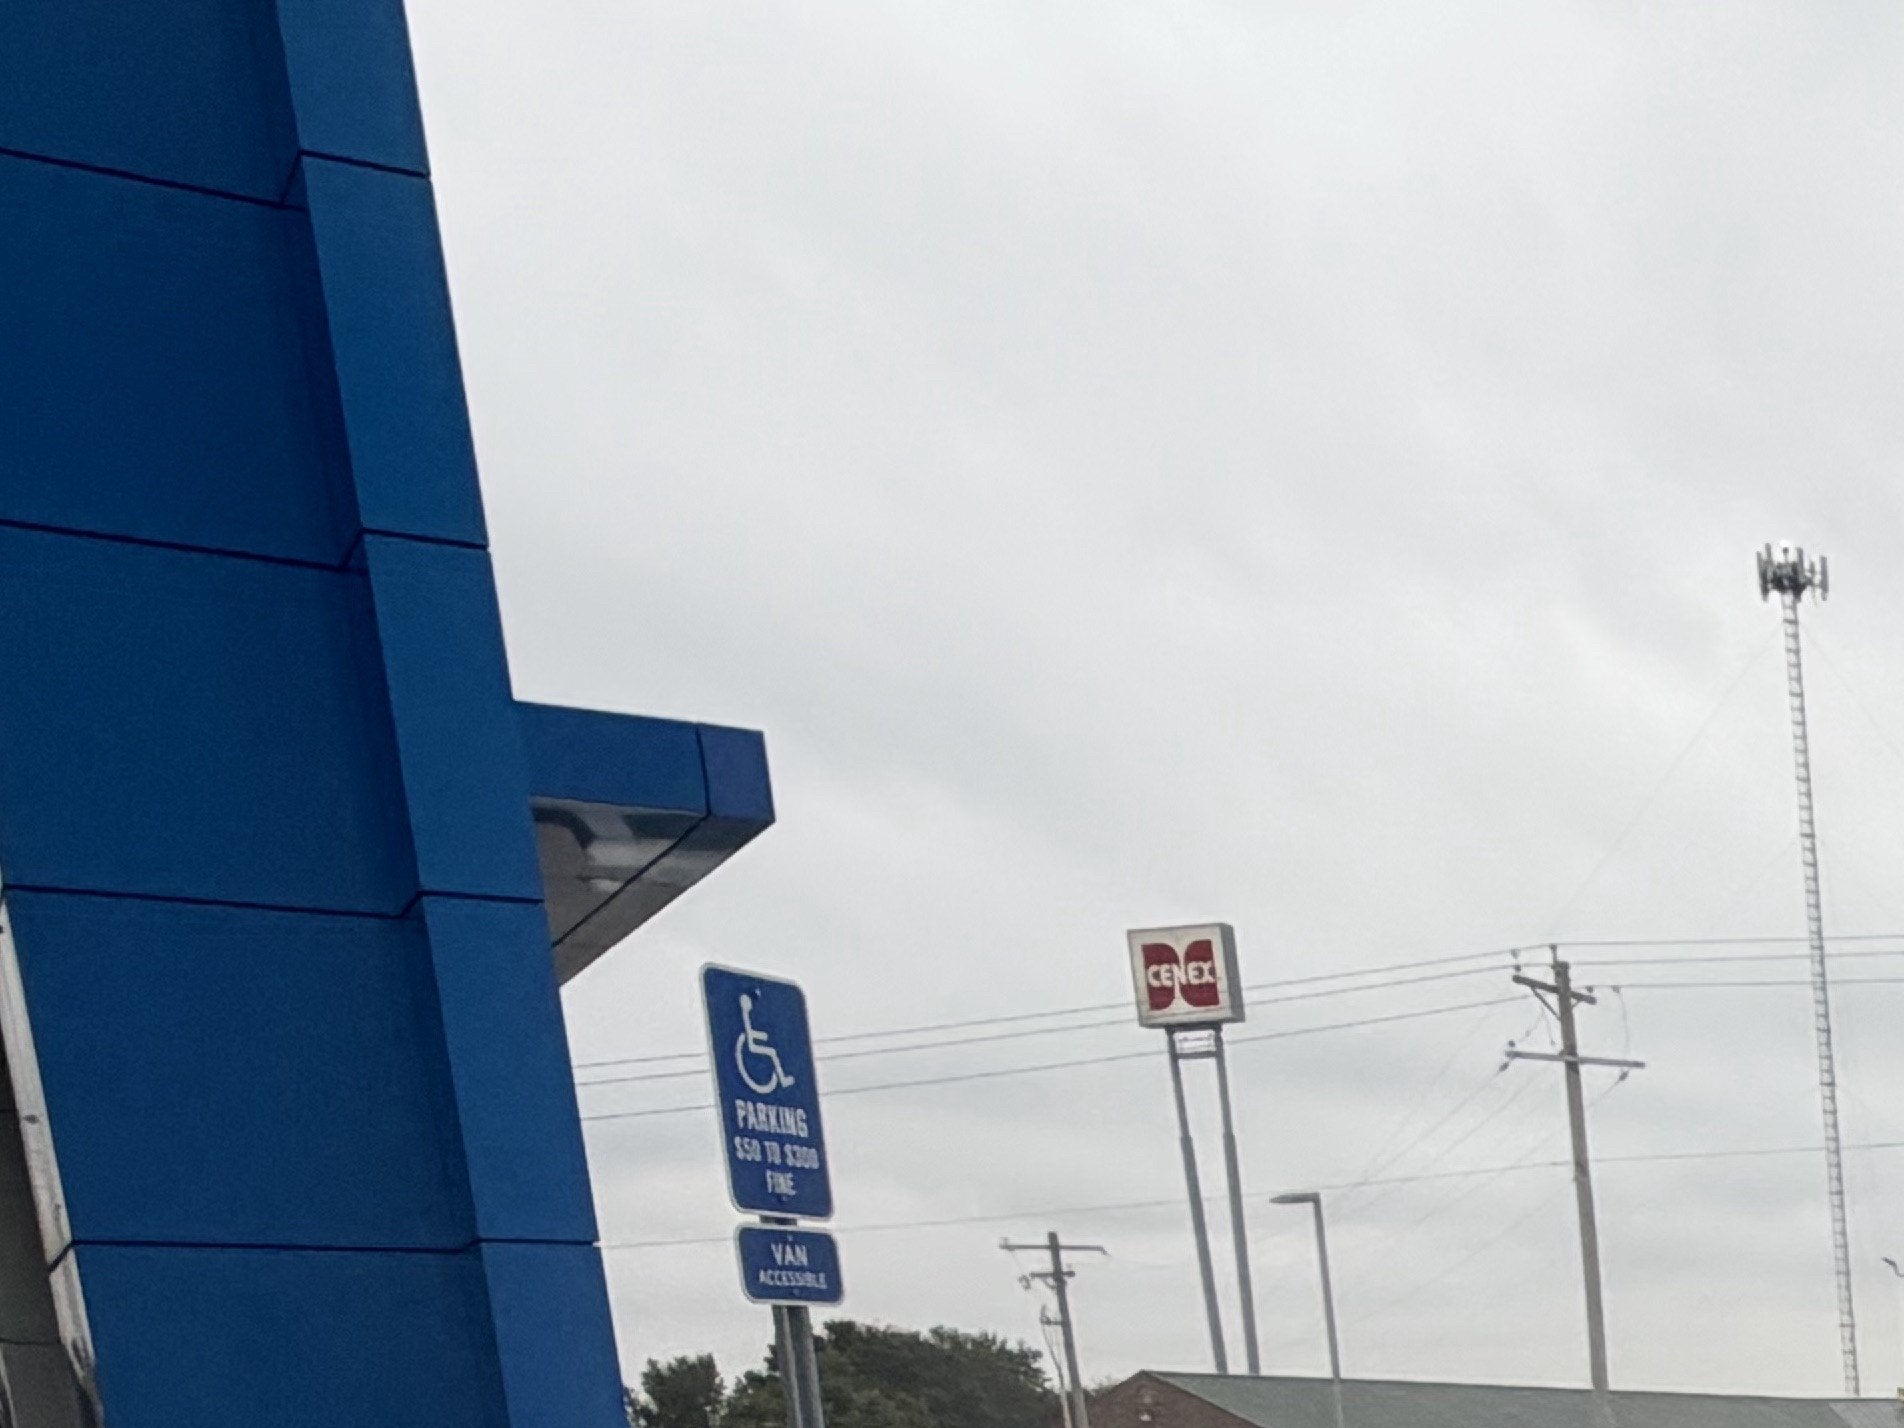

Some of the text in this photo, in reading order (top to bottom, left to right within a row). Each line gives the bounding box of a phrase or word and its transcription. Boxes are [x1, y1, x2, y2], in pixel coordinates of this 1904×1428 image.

[1147, 960, 1217, 988] CENEX
[735, 1099, 808, 1138] PARKING
[734, 1136, 762, 1162] $50
[764, 1140, 781, 1166] TO
[766, 1169, 797, 1196] FINE
[770, 1242, 808, 1266] VAN
[758, 1269, 828, 1289] ACCESSIBLE
